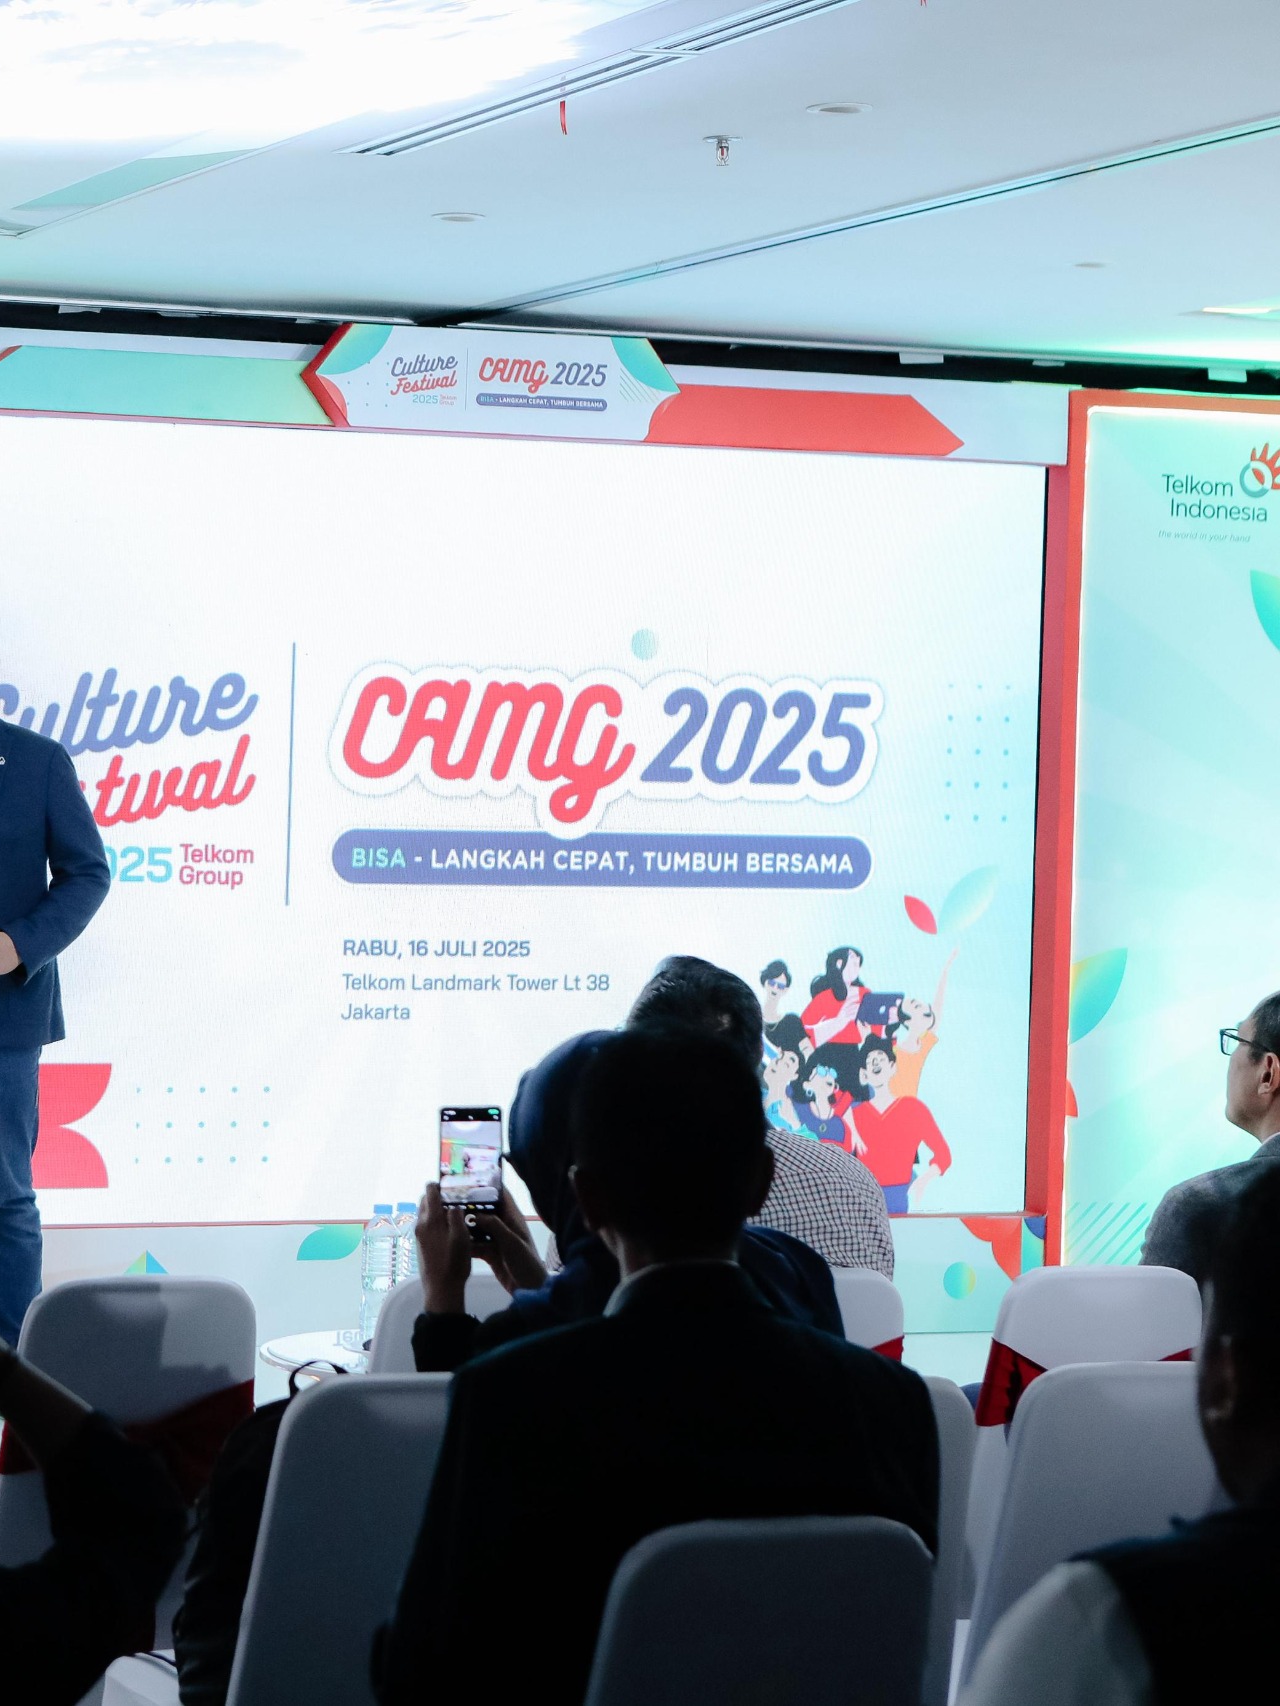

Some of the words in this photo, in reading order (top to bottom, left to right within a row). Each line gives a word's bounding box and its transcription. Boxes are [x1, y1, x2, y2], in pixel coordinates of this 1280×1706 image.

[391, 354, 458, 377] Culture
[550, 362, 608, 387] 2025
[389, 370, 457, 395] Festival
[412, 394, 438, 404] 2025
[528, 398, 549, 406] CEPAT,
[550, 399, 575, 407] TUMBUH
[575, 400, 603, 408] BERSAMA
[1161, 473, 1234, 497] Telkom
[1170, 498, 1267, 522] Indonesia
[1158, 530, 1172, 538] the
[640, 687, 872, 787] 2025
[80, 734, 256, 827] tival
[104, 845, 173, 883] 25
[179, 843, 254, 864] Telkom
[351, 847, 407, 868] BISA
[431, 848, 545, 870] LANGKAH
[553, 850, 635, 875] CEPAT,
[643, 851, 738, 873] TUMBUH
[746, 853, 854, 874] BERSAMA
[179, 865, 244, 890] Group
[342, 939, 402, 960] RABU,
[408, 940, 428, 957] 16
[434, 940, 477, 957] JULI
[482, 940, 531, 957] 2025
[342, 973, 405, 991] Telkom
[411, 973, 500, 991] Landmark
[507, 973, 558, 991] Tower
[564, 974, 581, 991] Lt
[586, 974, 610, 991] 38
[340, 1003, 411, 1020] Jakarta
